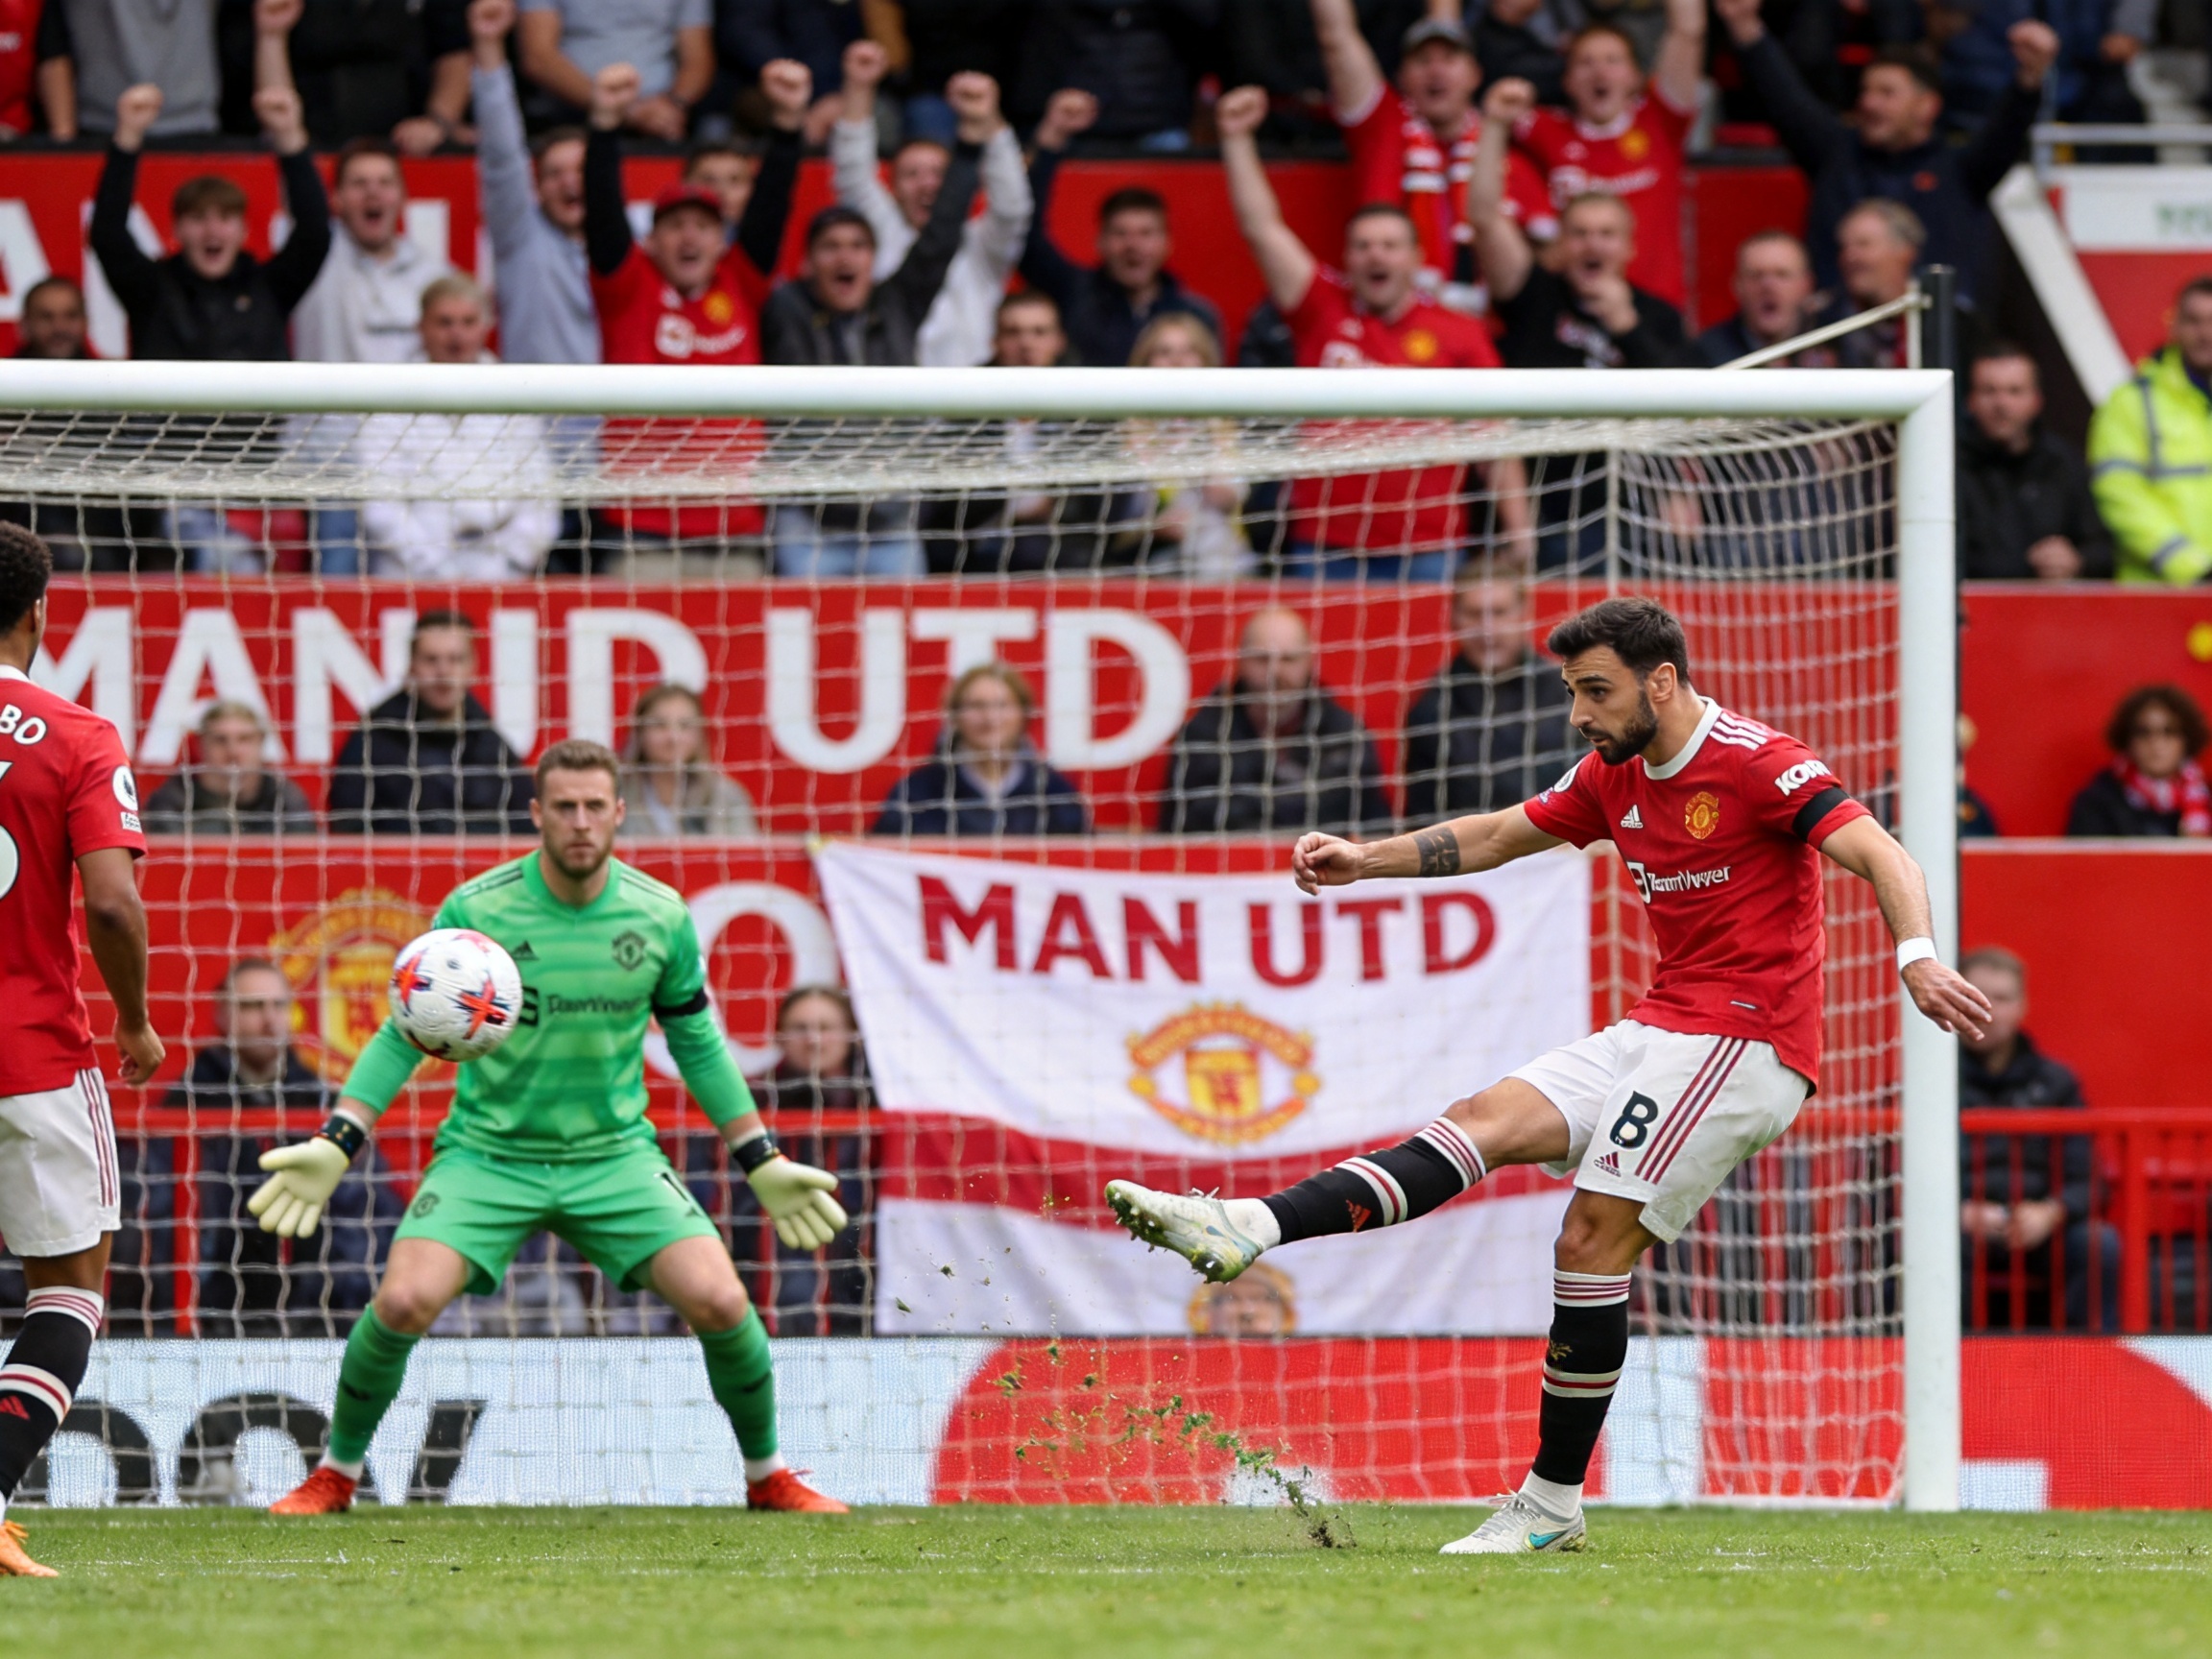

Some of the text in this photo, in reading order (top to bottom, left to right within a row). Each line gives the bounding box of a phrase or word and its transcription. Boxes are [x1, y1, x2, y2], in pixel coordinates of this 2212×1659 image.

[768, 607, 1191, 774] UTD
[917, 875, 1497, 989] MAN UTD
[1609, 1090, 1659, 1149] 8
